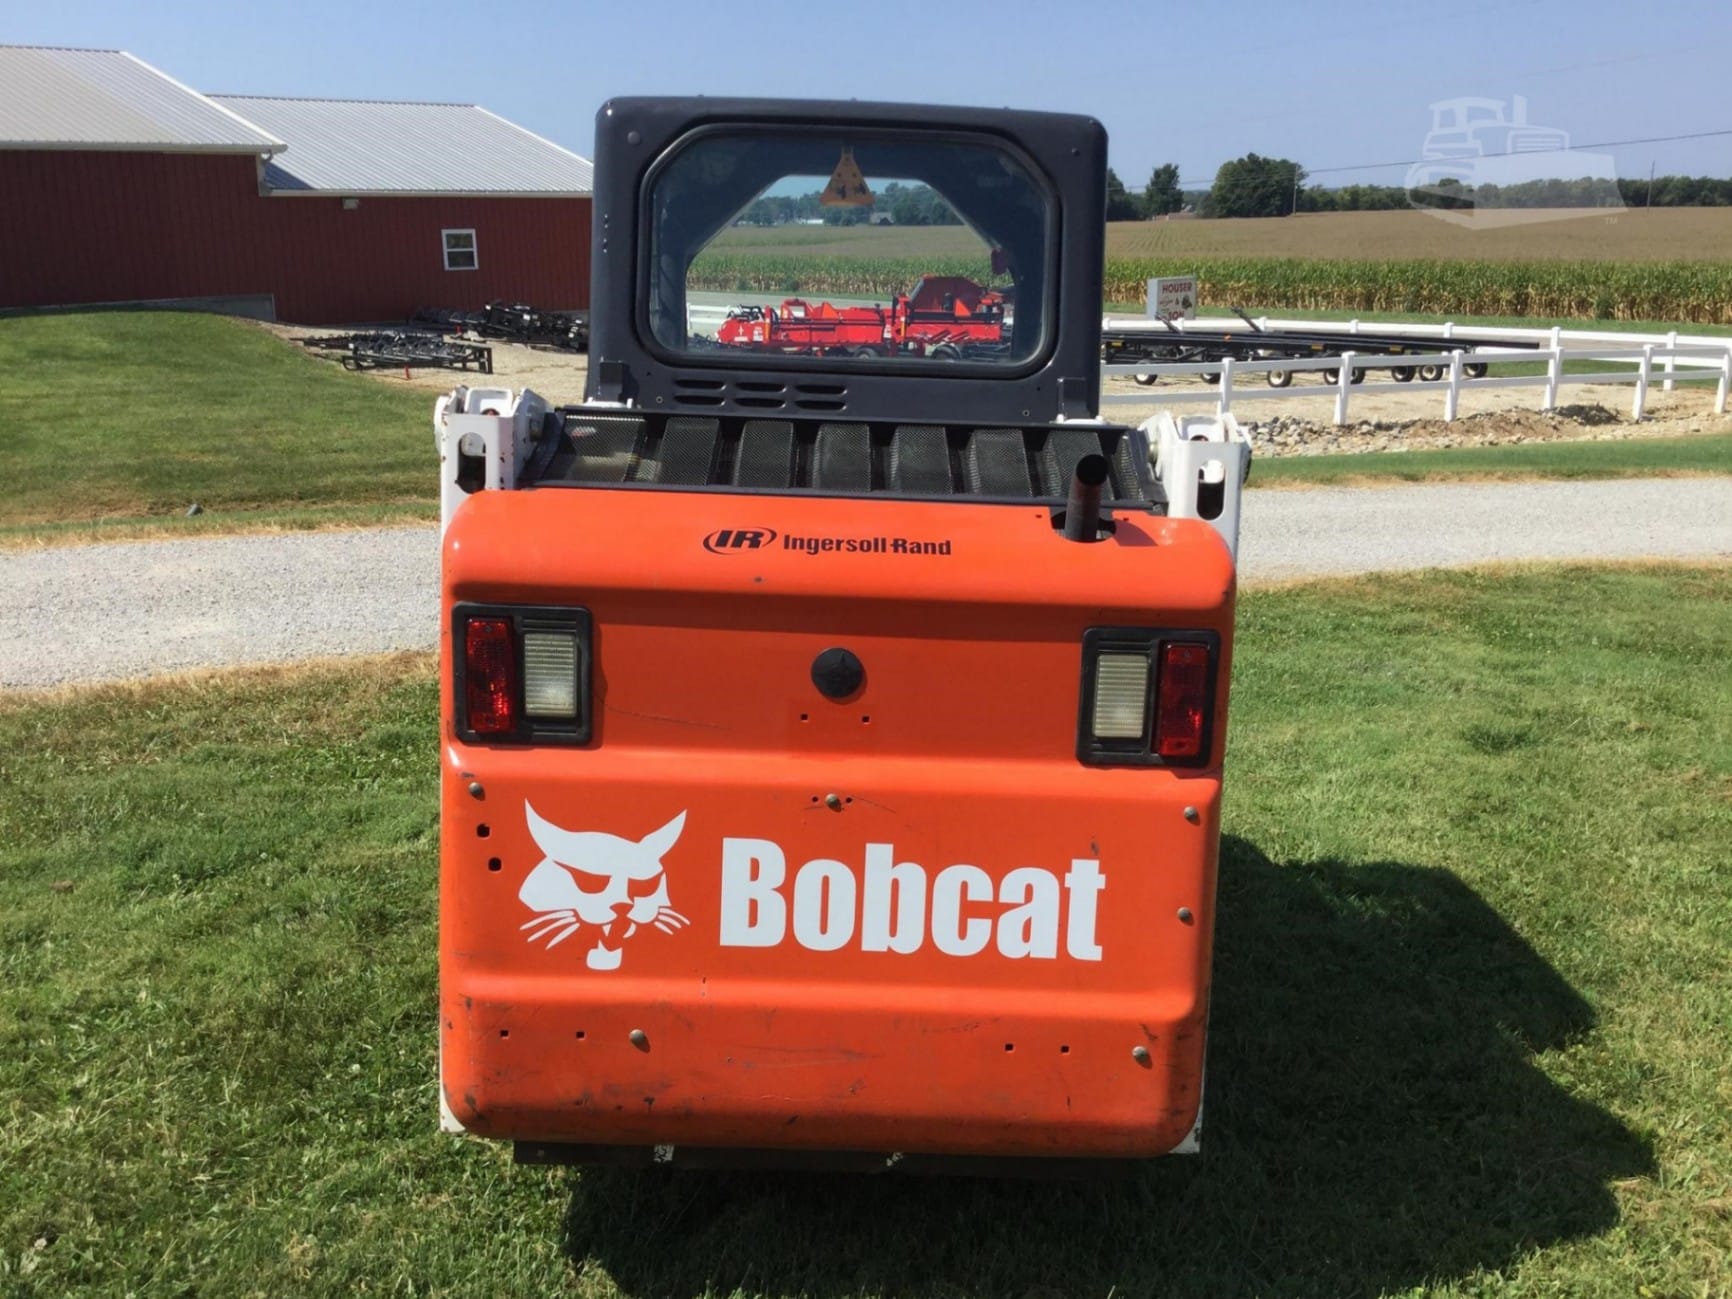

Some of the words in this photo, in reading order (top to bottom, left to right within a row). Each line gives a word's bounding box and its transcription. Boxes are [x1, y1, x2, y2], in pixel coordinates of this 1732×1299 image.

[1162, 282, 1192, 293] HOUSER
[714, 529, 766, 549] IR
[719, 837, 1106, 961] Bobcat
